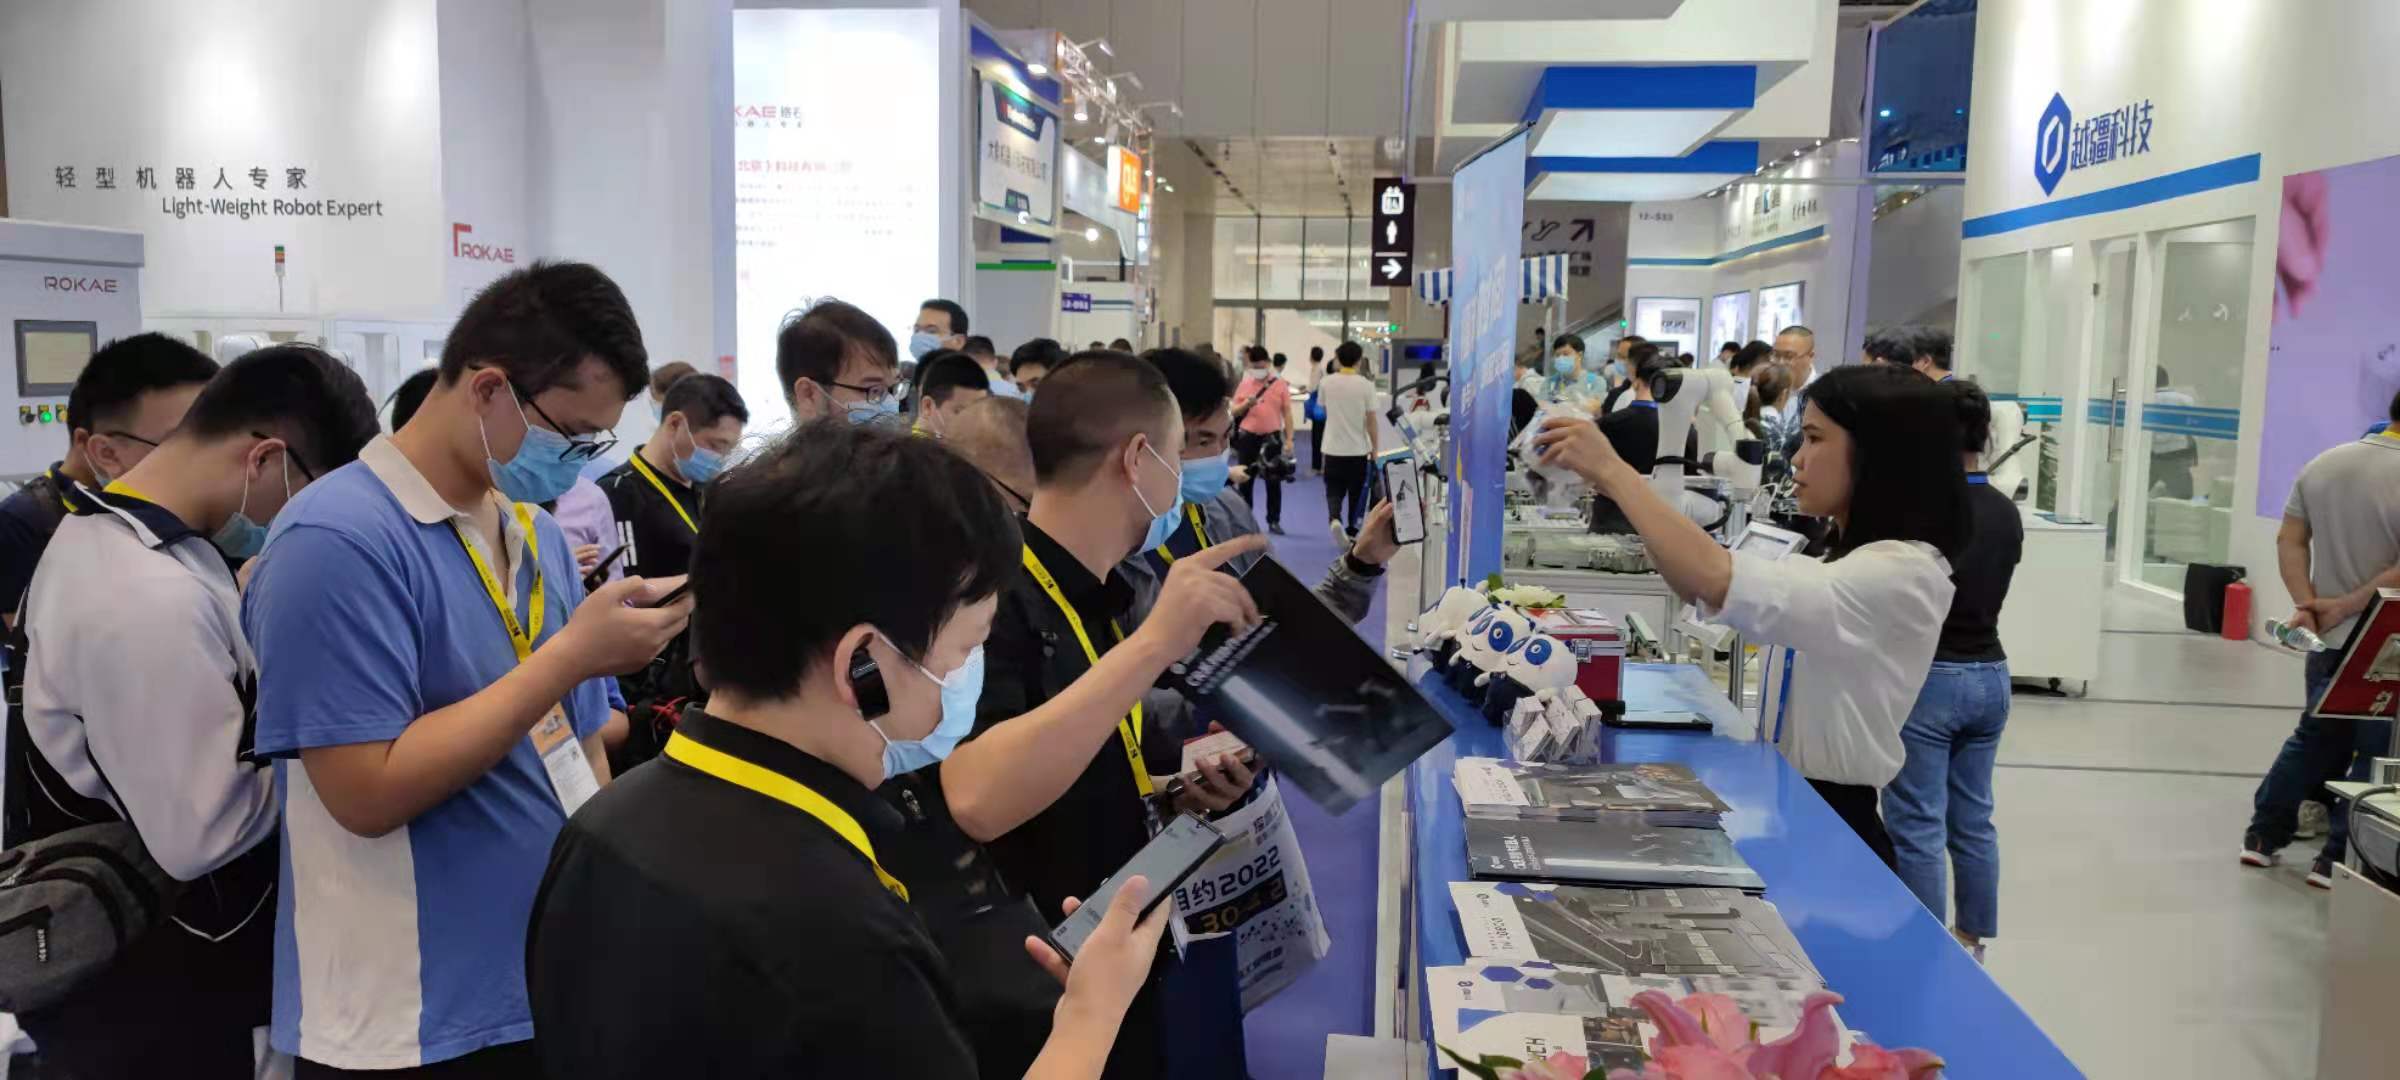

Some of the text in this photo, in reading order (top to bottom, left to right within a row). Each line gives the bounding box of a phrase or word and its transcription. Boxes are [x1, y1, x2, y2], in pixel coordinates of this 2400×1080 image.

[2070, 98, 2154, 170] 越疆科技
[54, 166, 308, 190] 轻型机器人专家
[162, 197, 383, 220] Light-Weight Robot Expert
[43, 276, 119, 293] ROKAE
